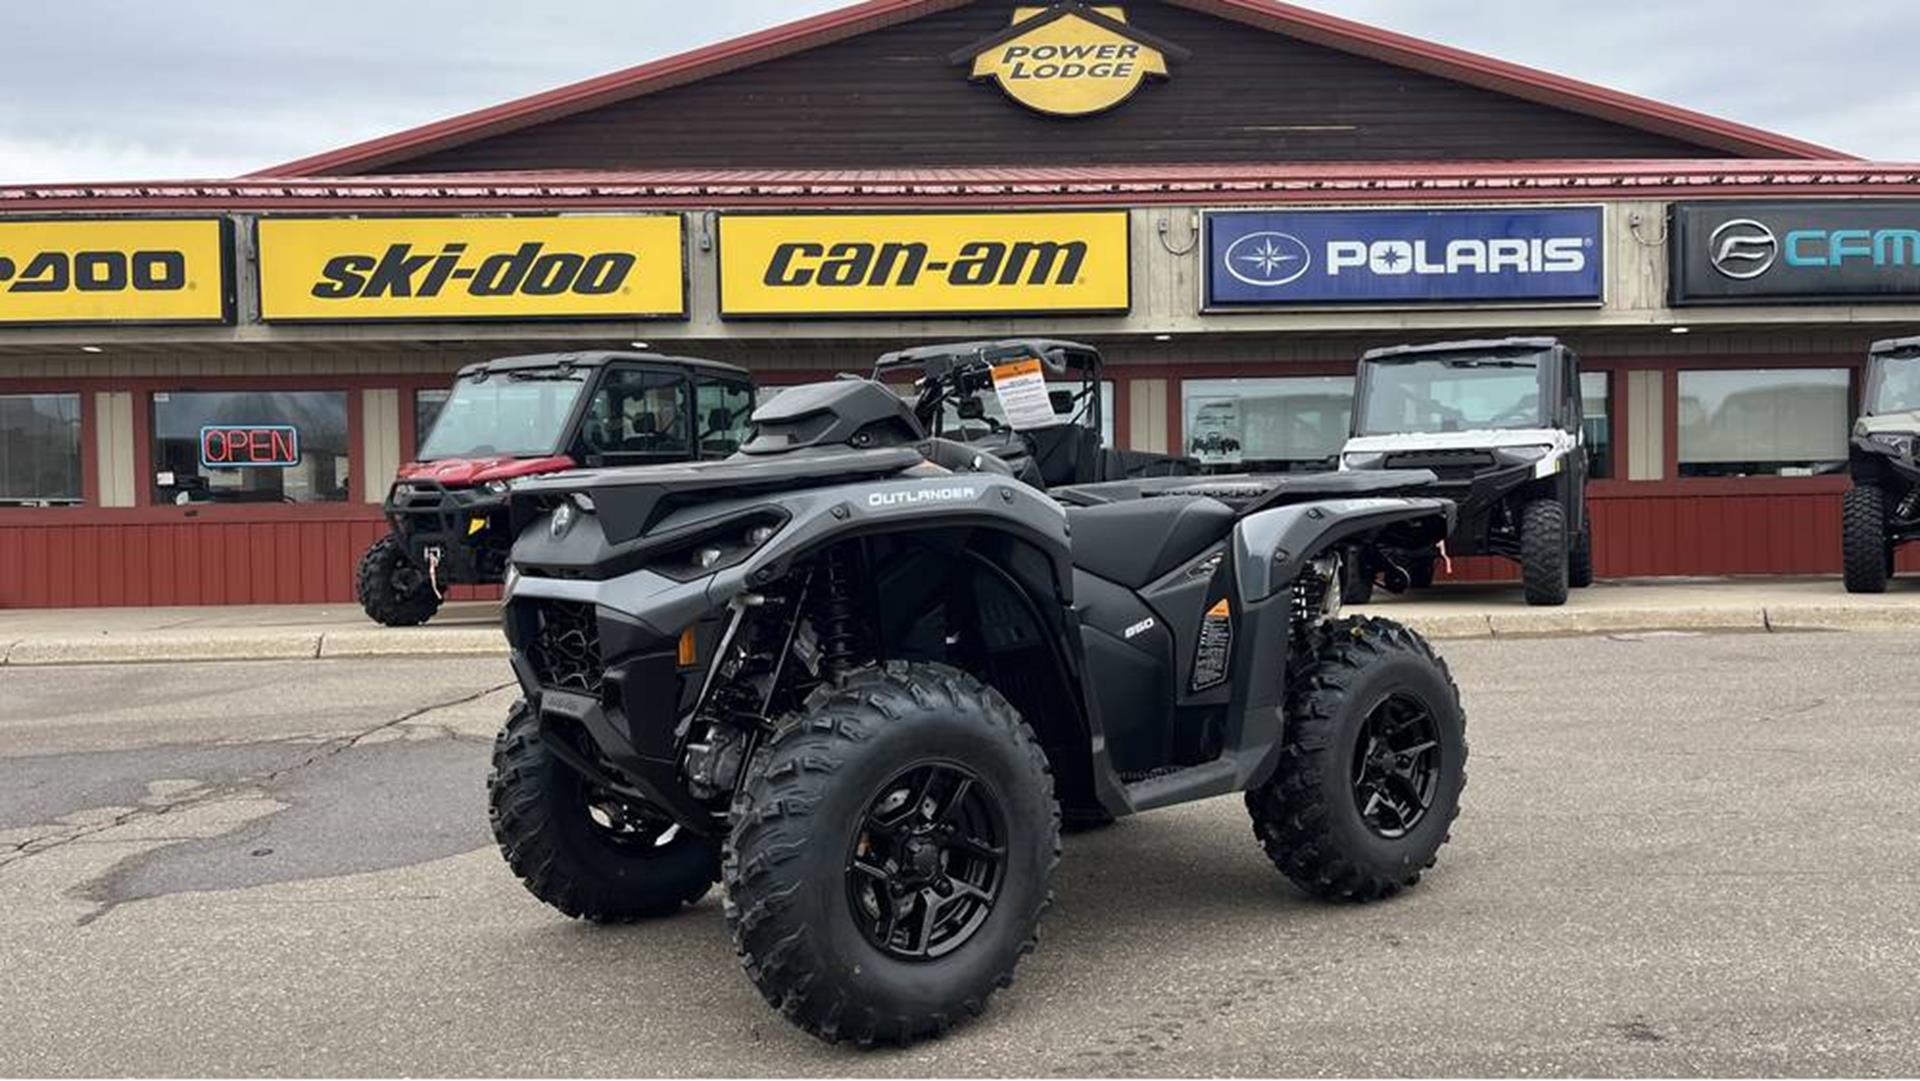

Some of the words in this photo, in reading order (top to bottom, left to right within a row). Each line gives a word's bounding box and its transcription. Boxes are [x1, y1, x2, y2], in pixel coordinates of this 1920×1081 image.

[1002, 44, 1139, 64] POWER
[1010, 62, 1133, 80] LODGE
[311, 241, 637, 299] ski-doo
[763, 239, 1088, 288] can-am
[1326, 237, 1586, 275] POLARIS
[205, 429, 293, 462] OPEN
[868, 487, 975, 507] OUTLANDER
